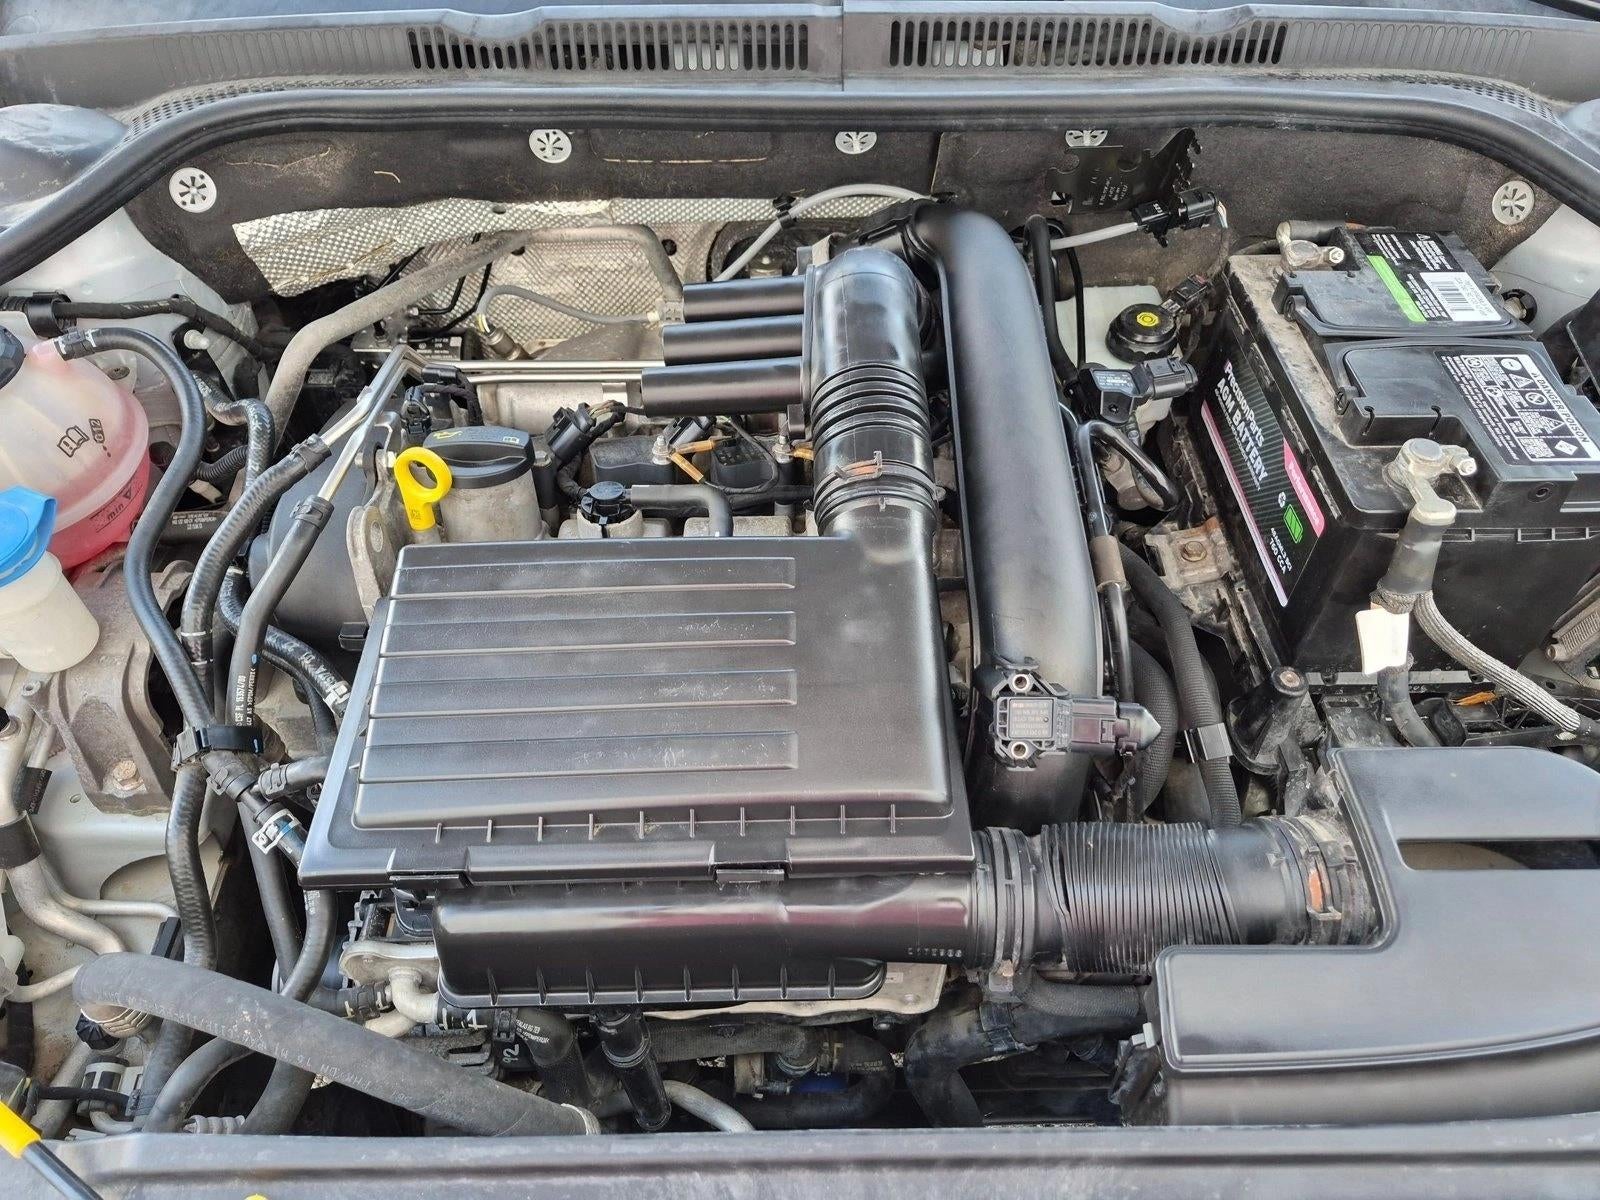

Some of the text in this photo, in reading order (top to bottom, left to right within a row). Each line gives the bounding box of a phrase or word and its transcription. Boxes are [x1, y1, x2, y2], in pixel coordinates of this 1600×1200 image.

[1217, 378, 1236, 413] AGM
[1232, 409, 1268, 482] BATTERY
[107, 503, 125, 521] min
